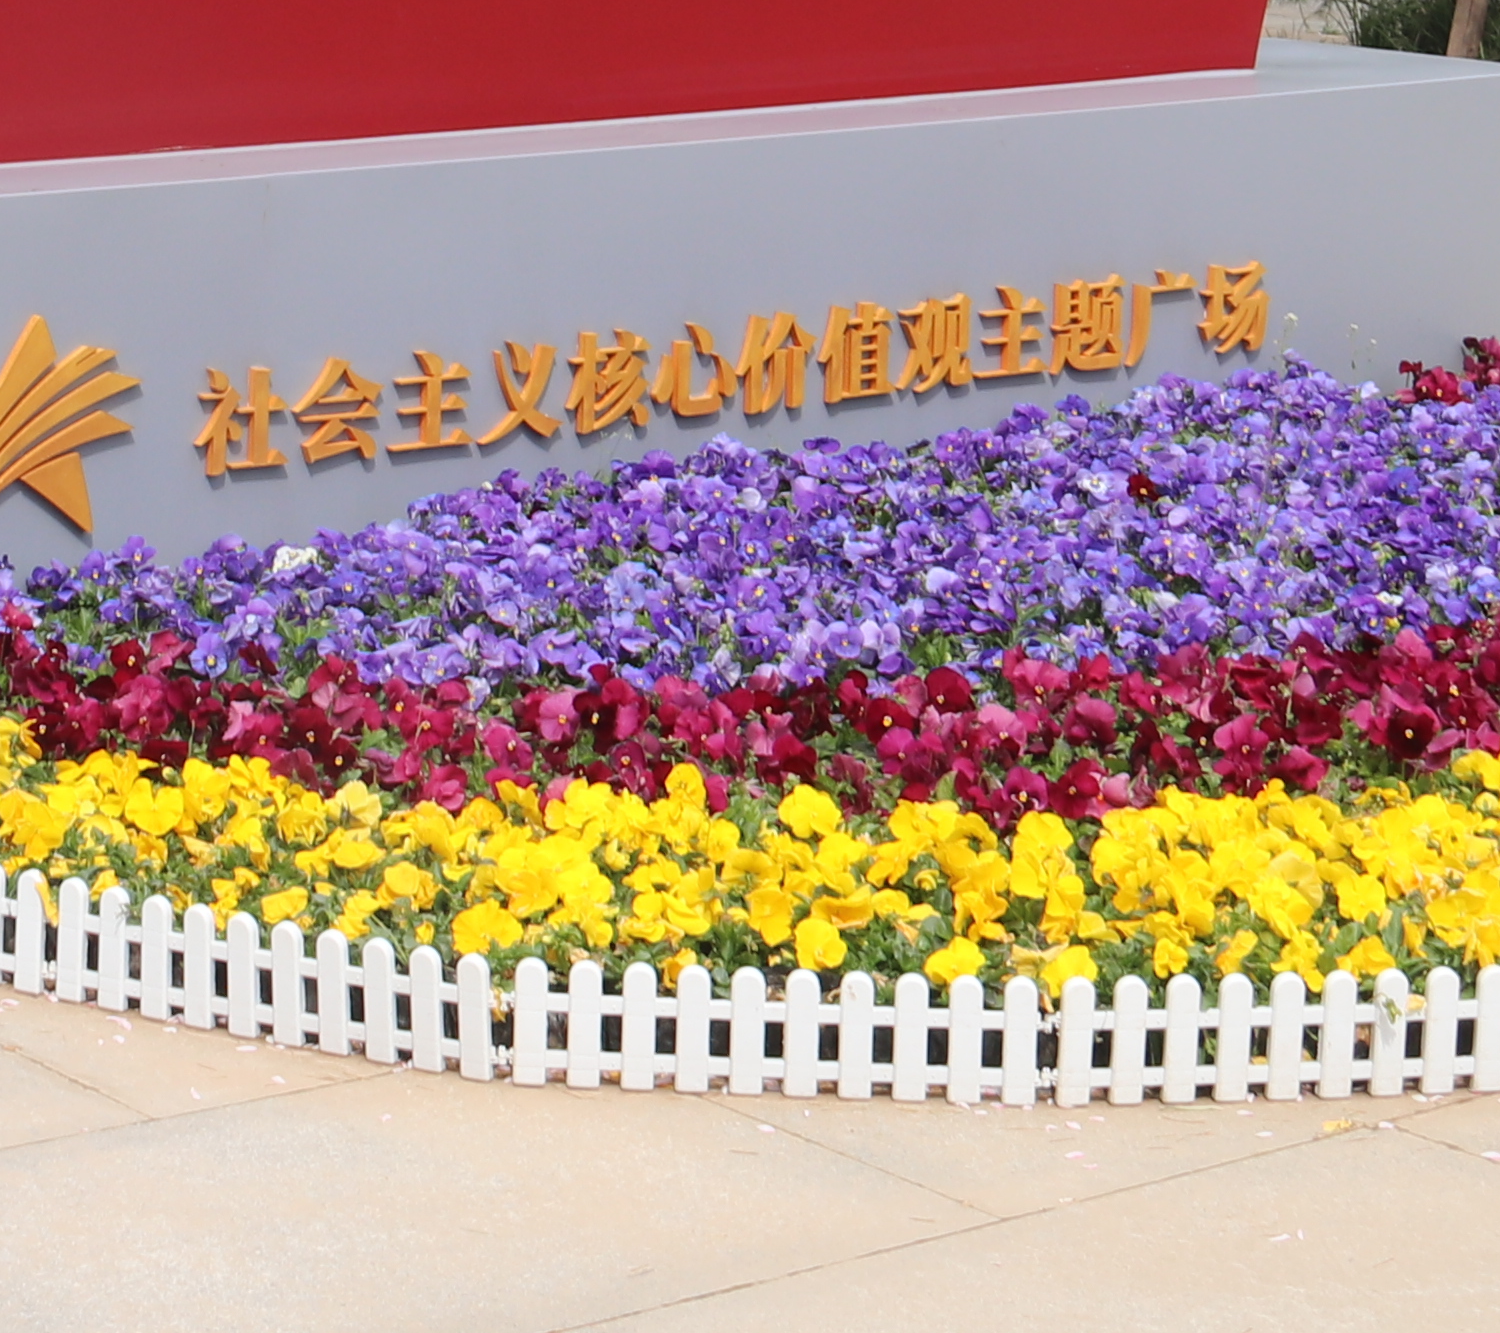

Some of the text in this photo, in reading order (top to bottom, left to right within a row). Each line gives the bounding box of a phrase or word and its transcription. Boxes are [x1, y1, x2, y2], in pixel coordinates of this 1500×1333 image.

[193, 259, 1270, 478] 社会主义核心价值观主题广场
